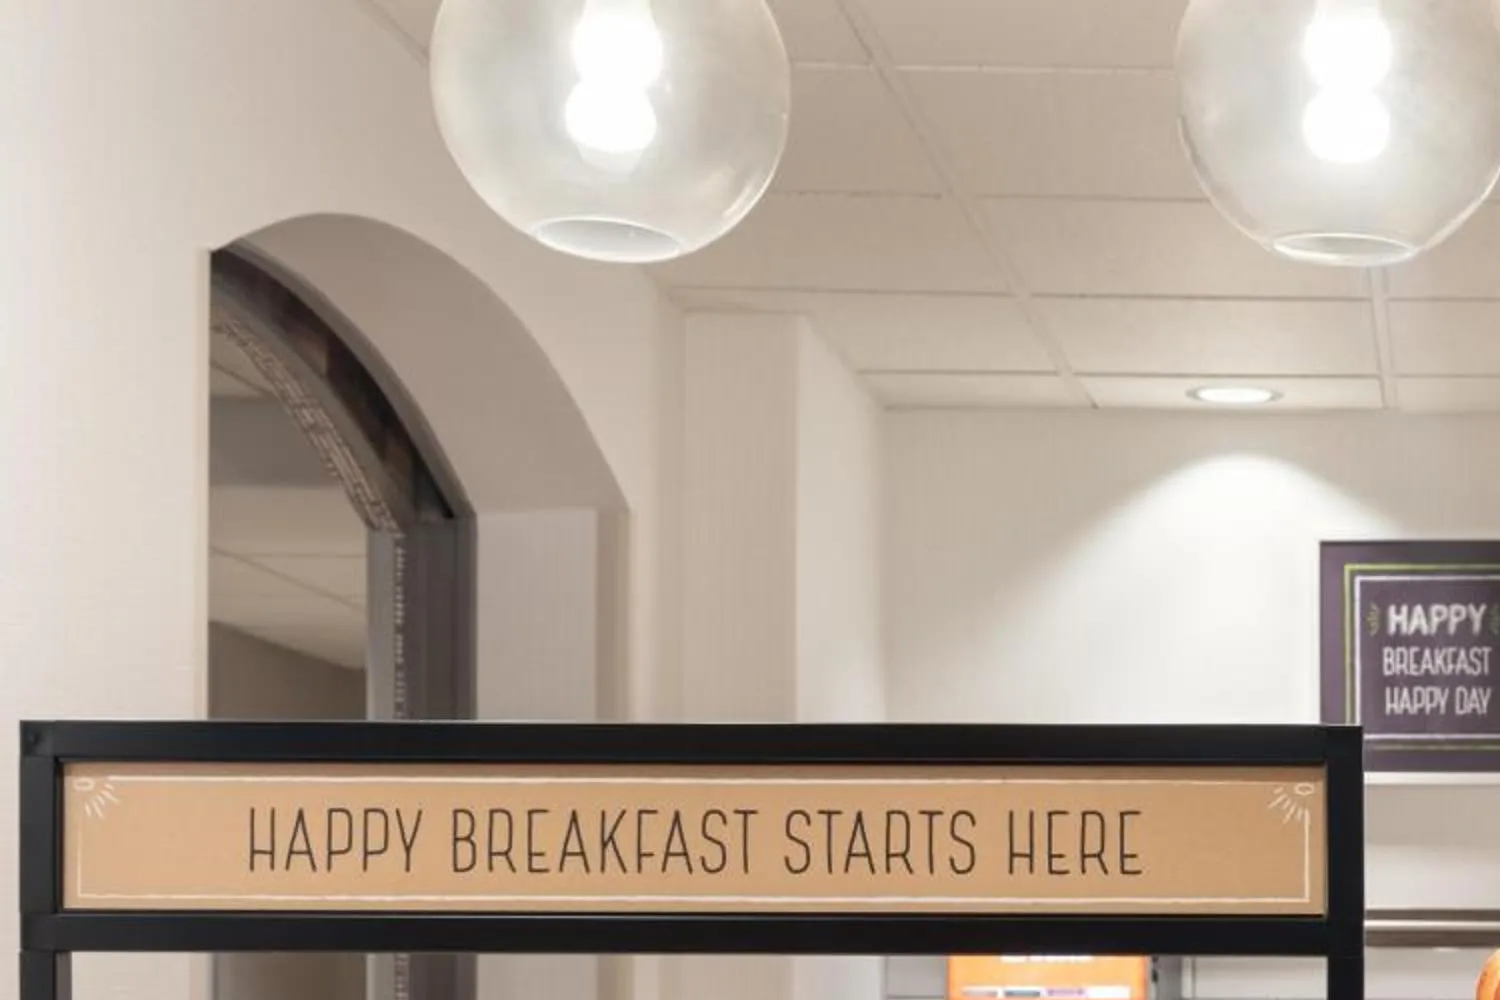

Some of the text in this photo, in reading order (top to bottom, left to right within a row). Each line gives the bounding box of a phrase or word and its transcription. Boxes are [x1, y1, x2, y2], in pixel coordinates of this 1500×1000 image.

[1387, 603, 1487, 636] HAPPY
[1382, 646, 1492, 677] BREAKFAST
[1385, 686, 1492, 716] HAPPY DAY
[249, 807, 1144, 877] HAPPY BREAKFAST STARTS HERE
